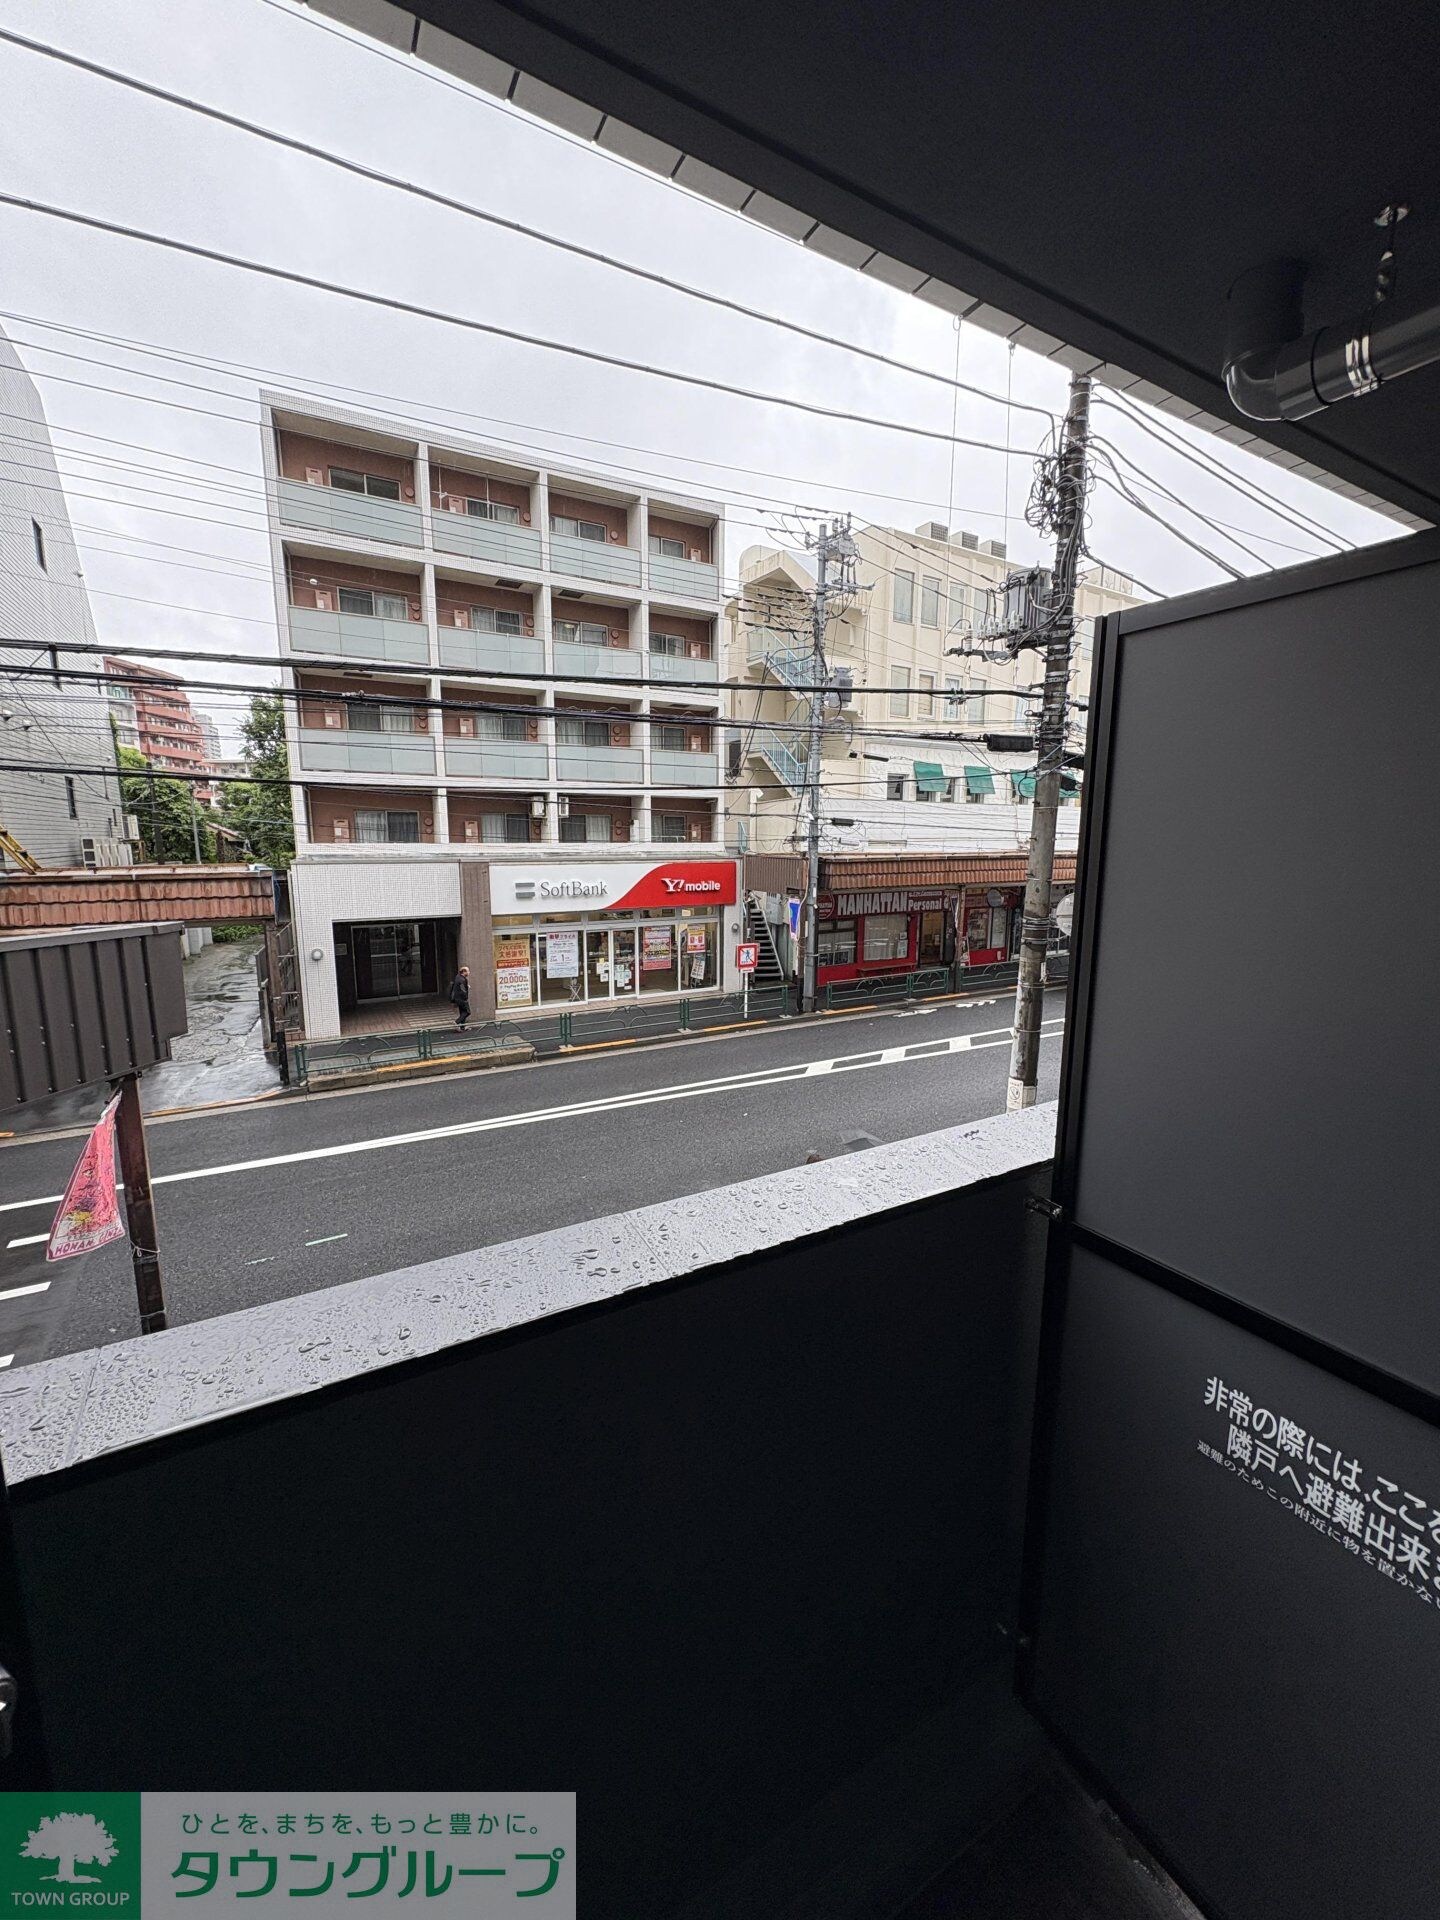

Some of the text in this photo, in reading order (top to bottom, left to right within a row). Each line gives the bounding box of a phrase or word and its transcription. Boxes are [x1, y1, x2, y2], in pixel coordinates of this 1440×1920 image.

[540, 881, 608, 897] SoftBank
[837, 891, 908, 916] MANHATTAN
[908, 898, 942, 911] Personal
[1197, 1440, 1440, 1609] 避難のためこの附近に物を置かな
